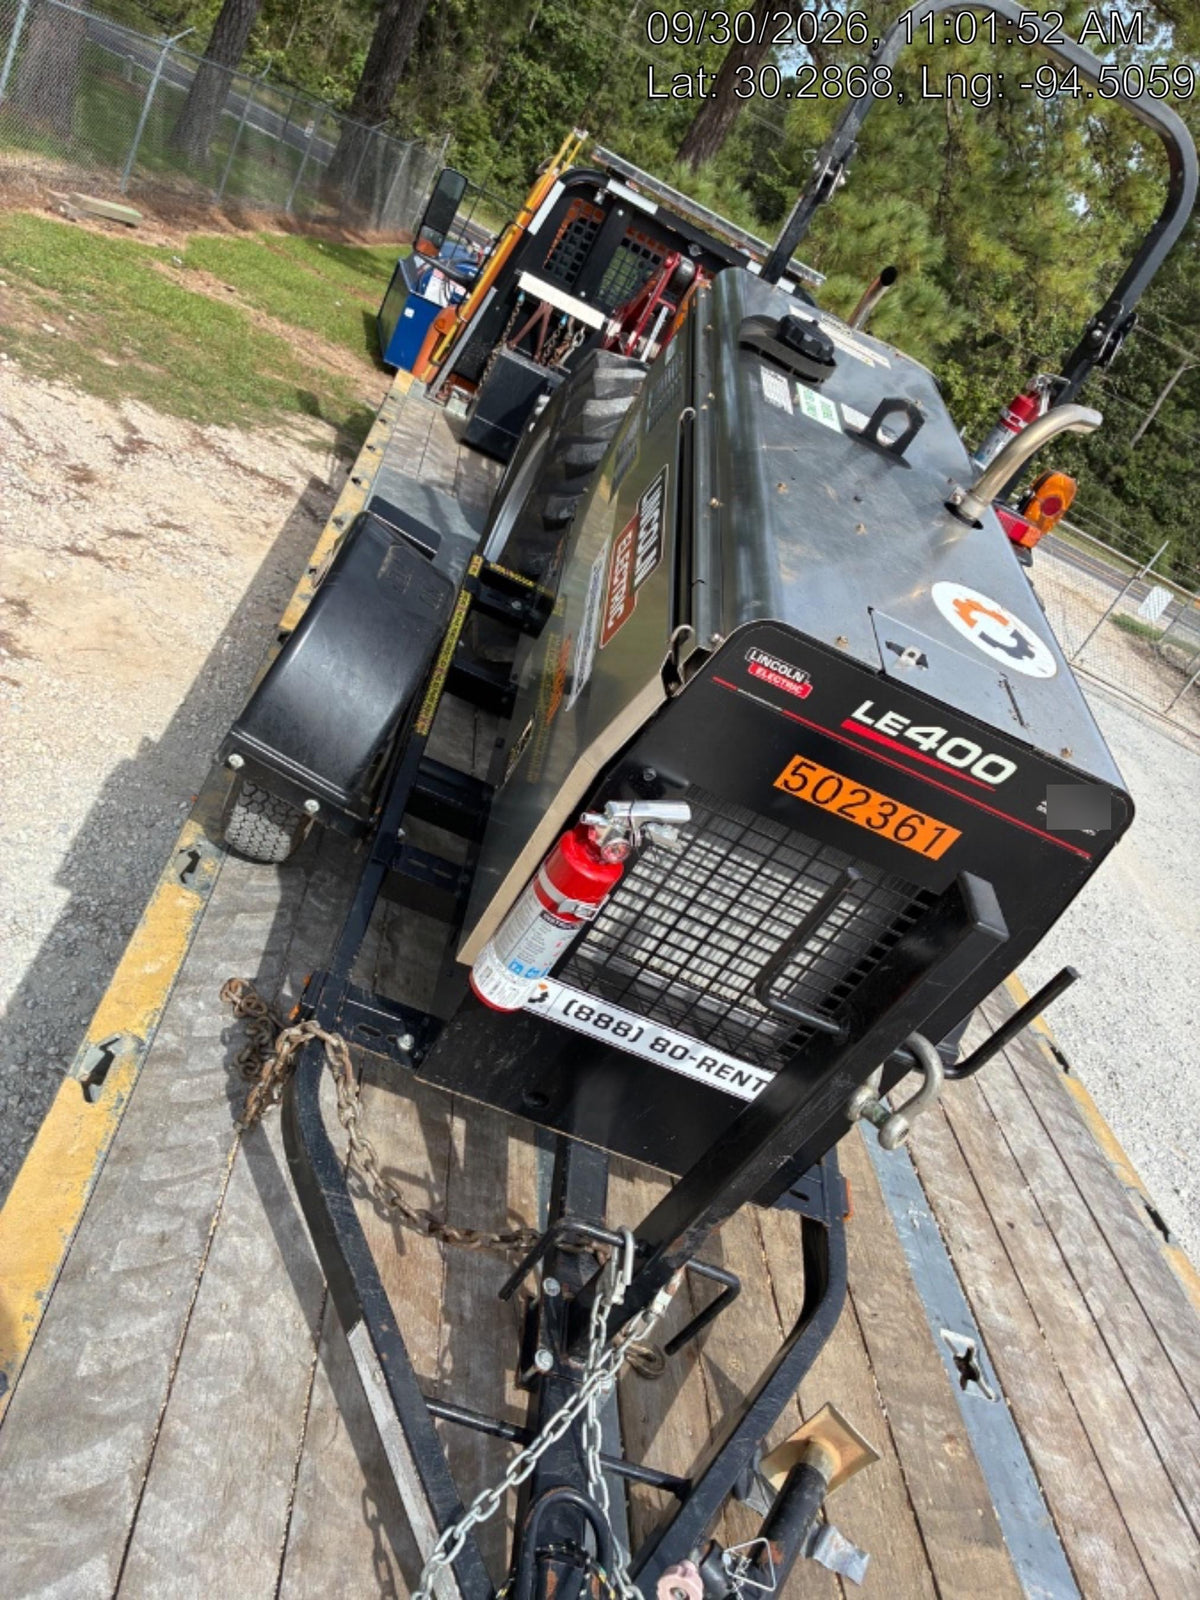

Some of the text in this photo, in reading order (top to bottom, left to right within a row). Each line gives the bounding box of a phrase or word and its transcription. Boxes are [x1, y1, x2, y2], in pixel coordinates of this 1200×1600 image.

[607, 528, 634, 629] ELECTRIC
[633, 474, 664, 588] LINCOLN
[749, 650, 805, 683] LINCOLN
[755, 666, 804, 695] ELECTRIC
[850, 700, 1018, 784] LE400
[782, 760, 948, 855] 502361
[562, 997, 769, 1093] (888) 80-RENT
